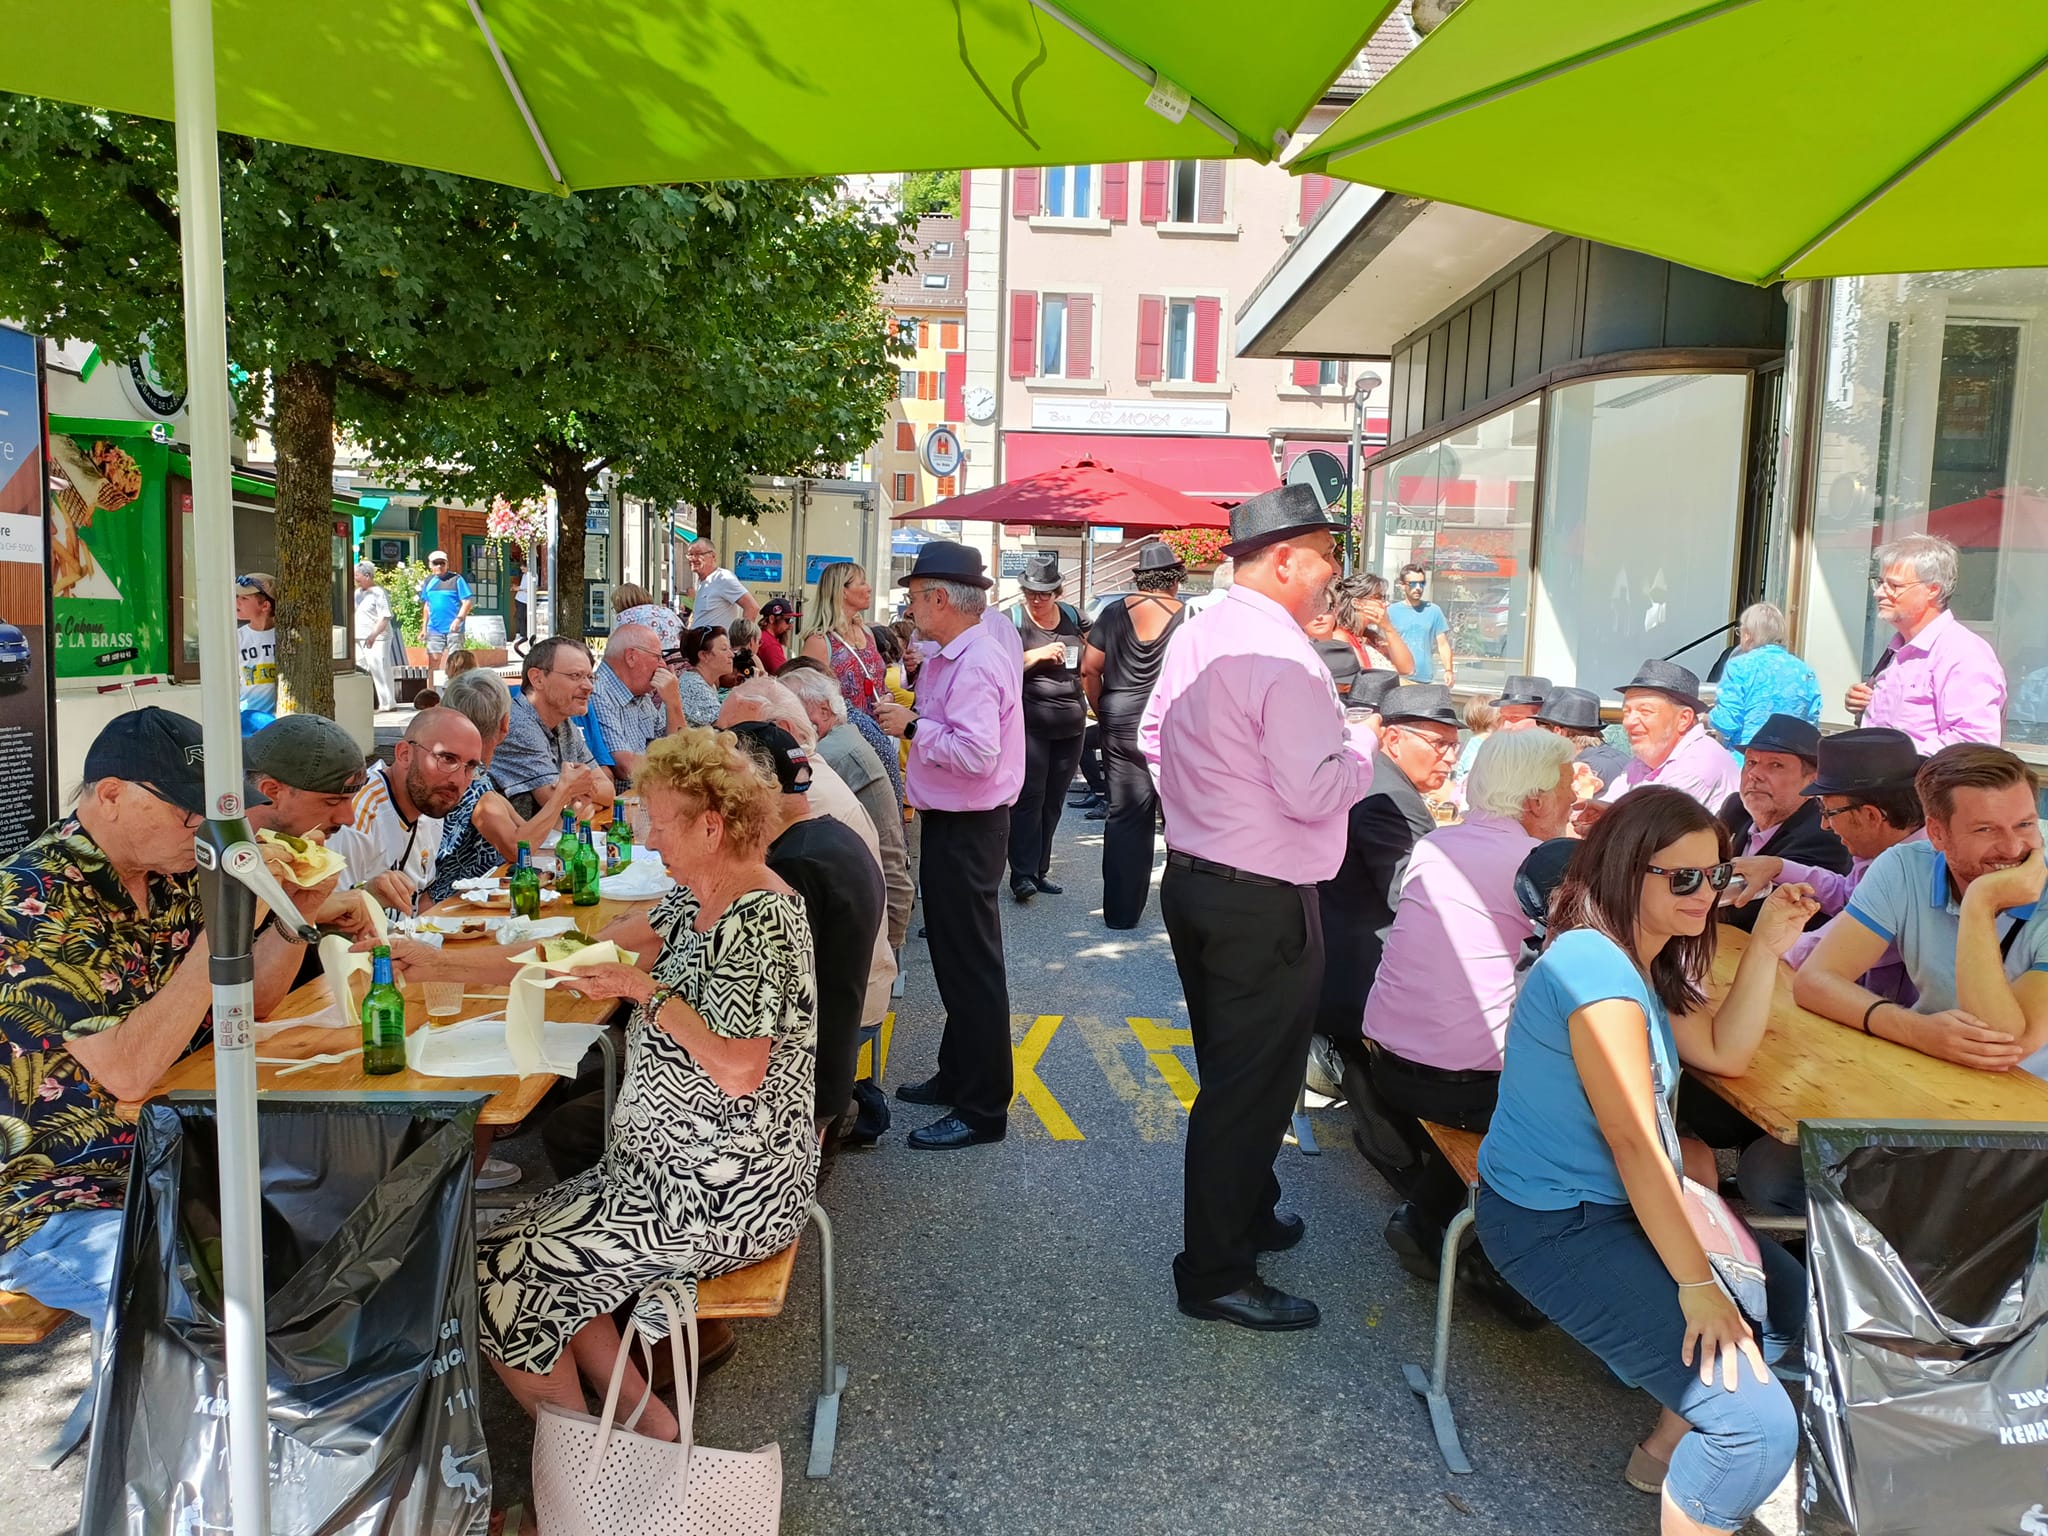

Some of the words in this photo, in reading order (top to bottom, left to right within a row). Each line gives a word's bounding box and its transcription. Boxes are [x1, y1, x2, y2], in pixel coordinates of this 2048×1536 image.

[1113, 412, 1172, 427] MOKA
[68, 633, 86, 648] LA
[91, 632, 133, 648] BRASS
[427, 1347, 466, 1380] RIC
[2008, 1385, 2048, 1410] ZUG
